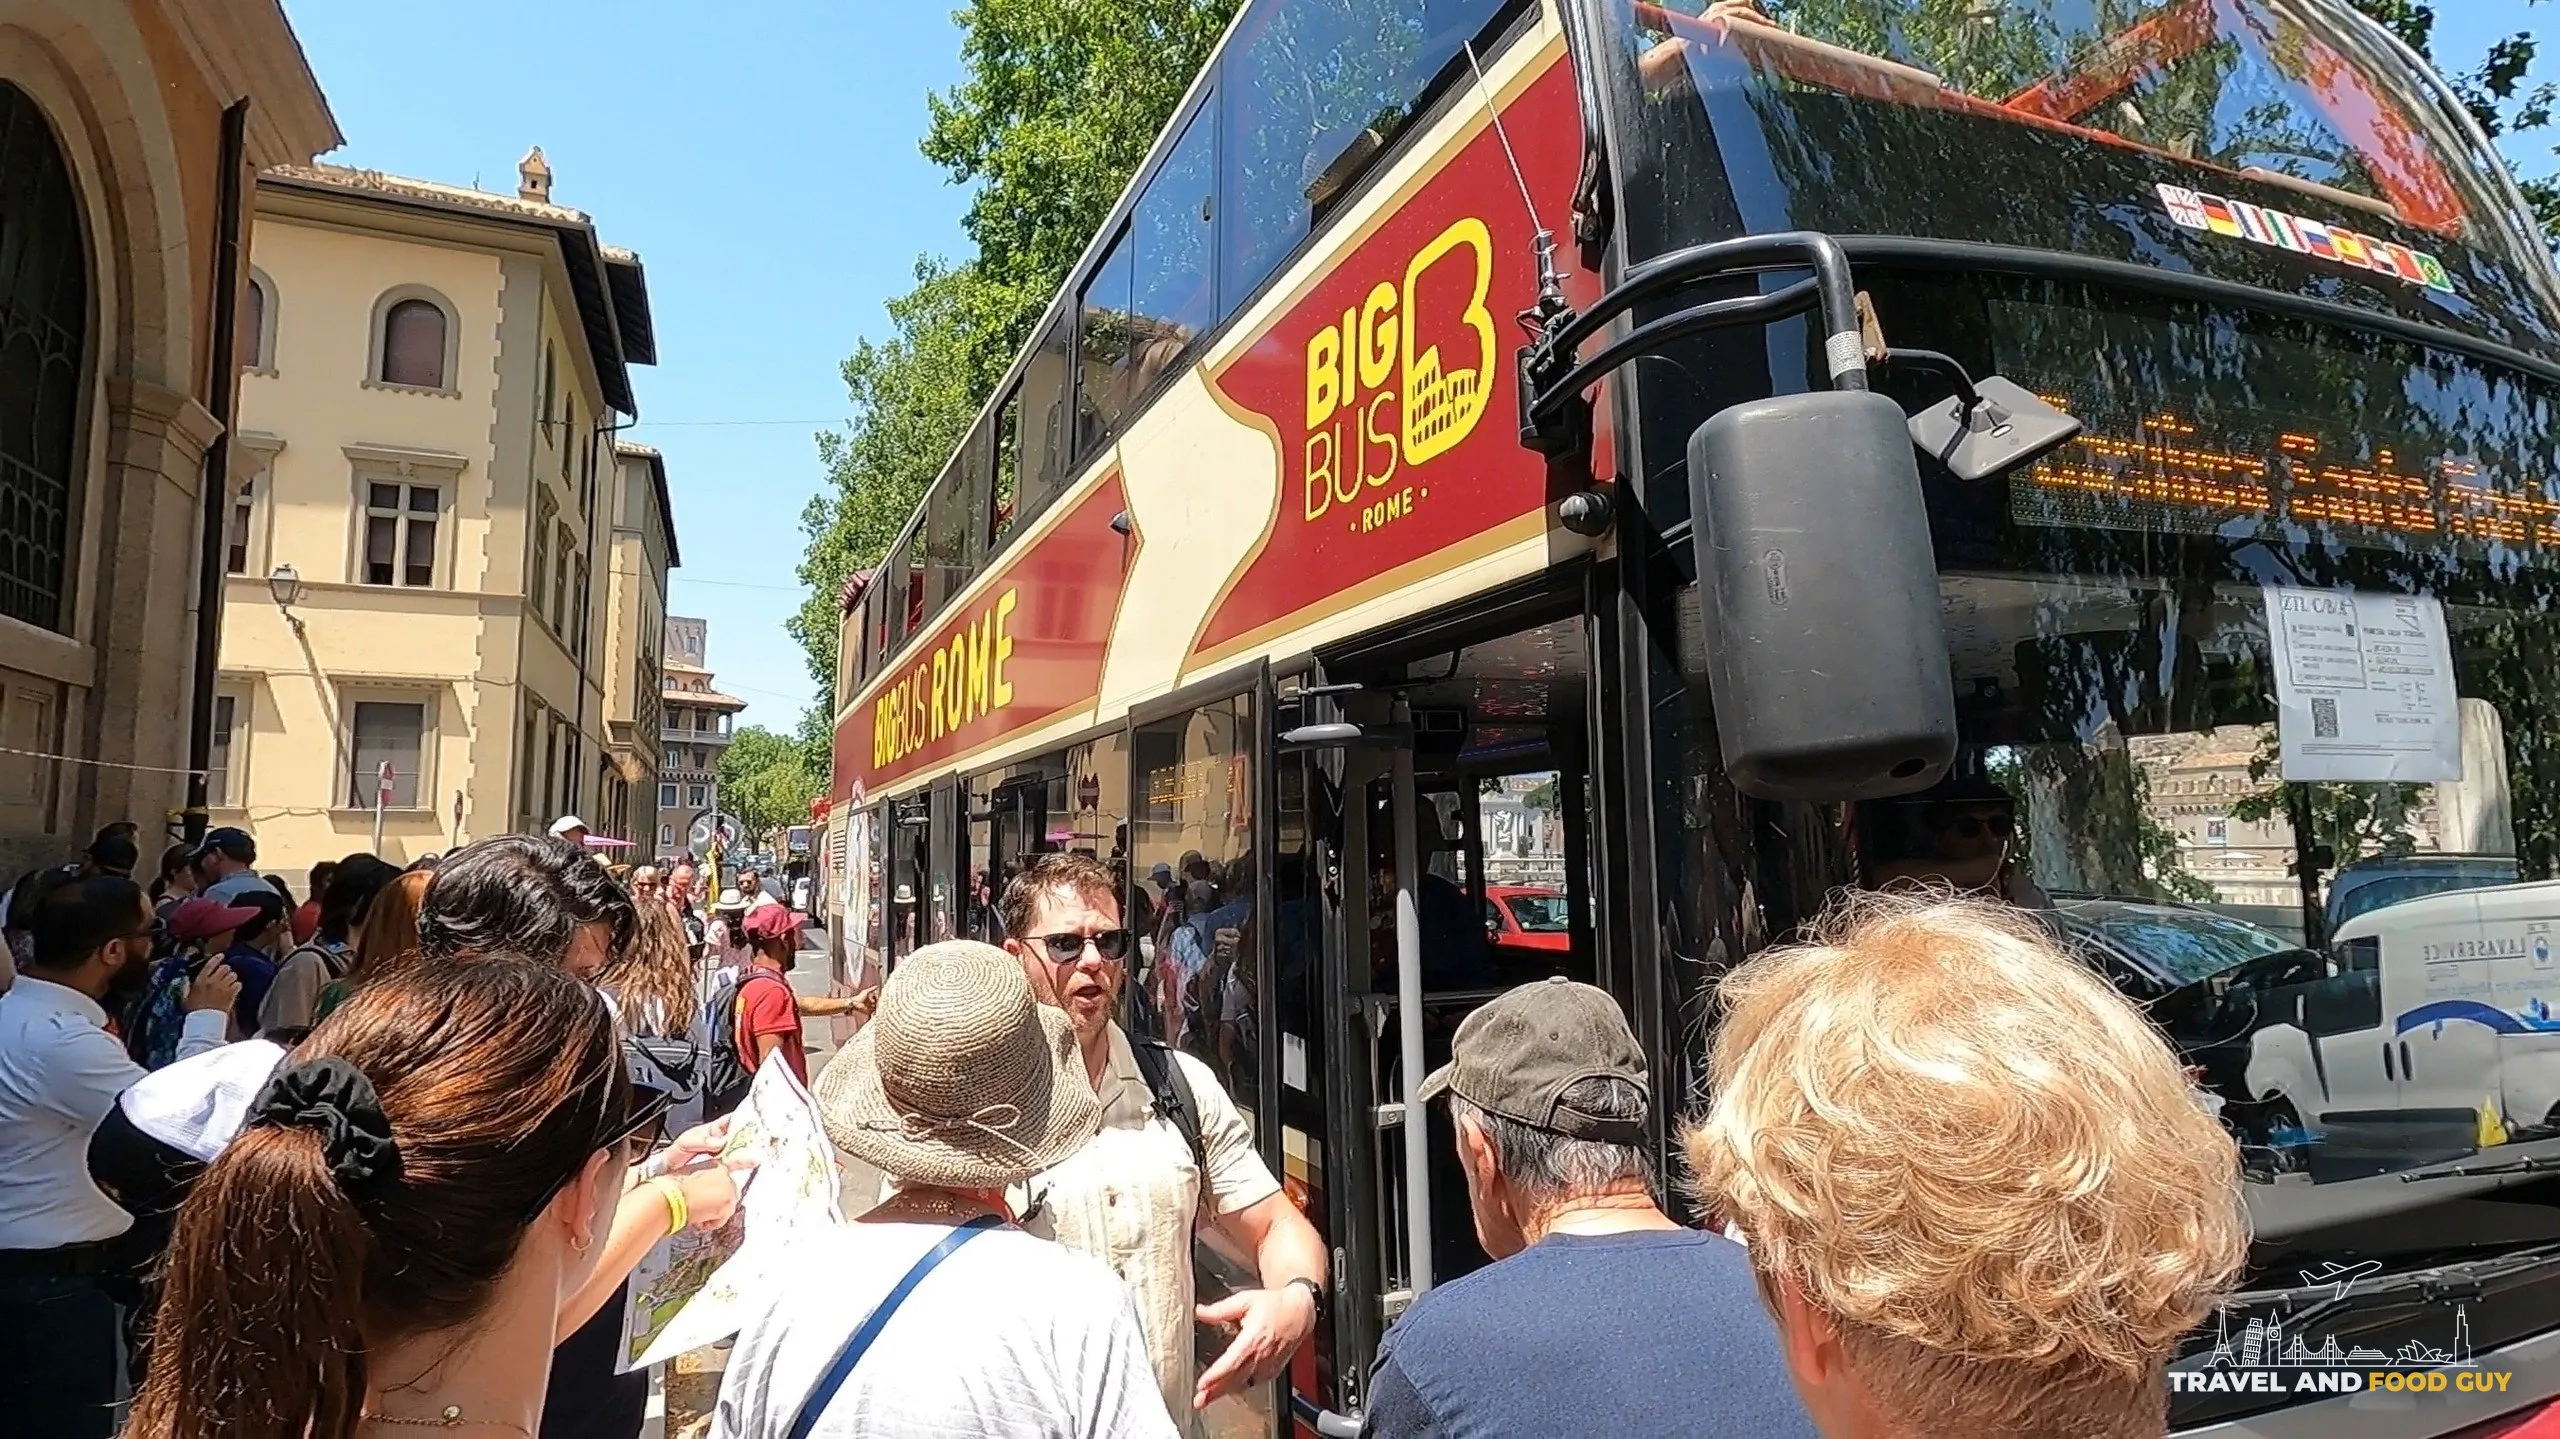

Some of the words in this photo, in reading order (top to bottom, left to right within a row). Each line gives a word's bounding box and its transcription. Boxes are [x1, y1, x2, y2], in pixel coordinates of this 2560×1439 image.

[1305, 281, 1399, 431] BIG
[1304, 390, 1398, 522] BUS
[1361, 486, 1414, 534] ROME
[930, 587, 1018, 742] ROME
